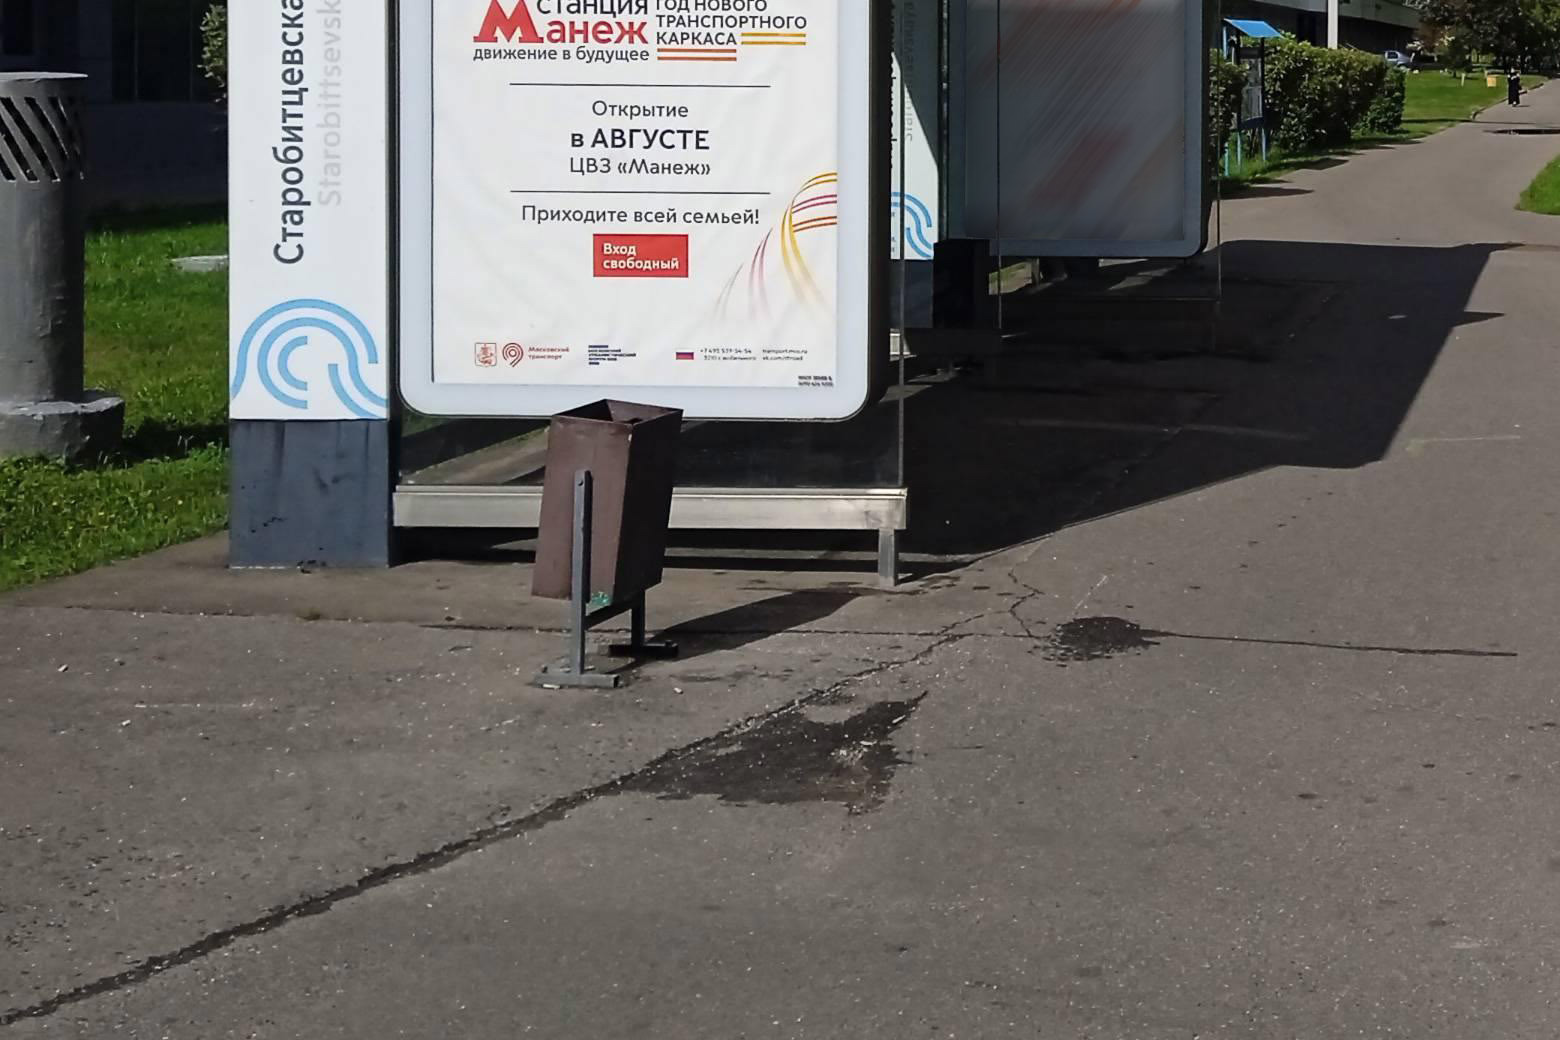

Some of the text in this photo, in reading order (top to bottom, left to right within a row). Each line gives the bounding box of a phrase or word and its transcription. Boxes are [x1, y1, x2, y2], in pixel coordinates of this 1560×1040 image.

[656, 14, 807, 29] ТРАНСПОРТНОГО
[656, 32, 737, 45] КАРКАСА
[473, 46, 650, 64] движение в будущее
[592, 100, 689, 120] Открытие
[571, 128, 710, 150] в АВГУСТЕ
[570, 157, 711, 176] ЦВЗ «Манеж»
[522, 205, 760, 225] Приходите всей семьей!
[603, 242, 637, 256] Вход
[603, 257, 679, 270] свободный
